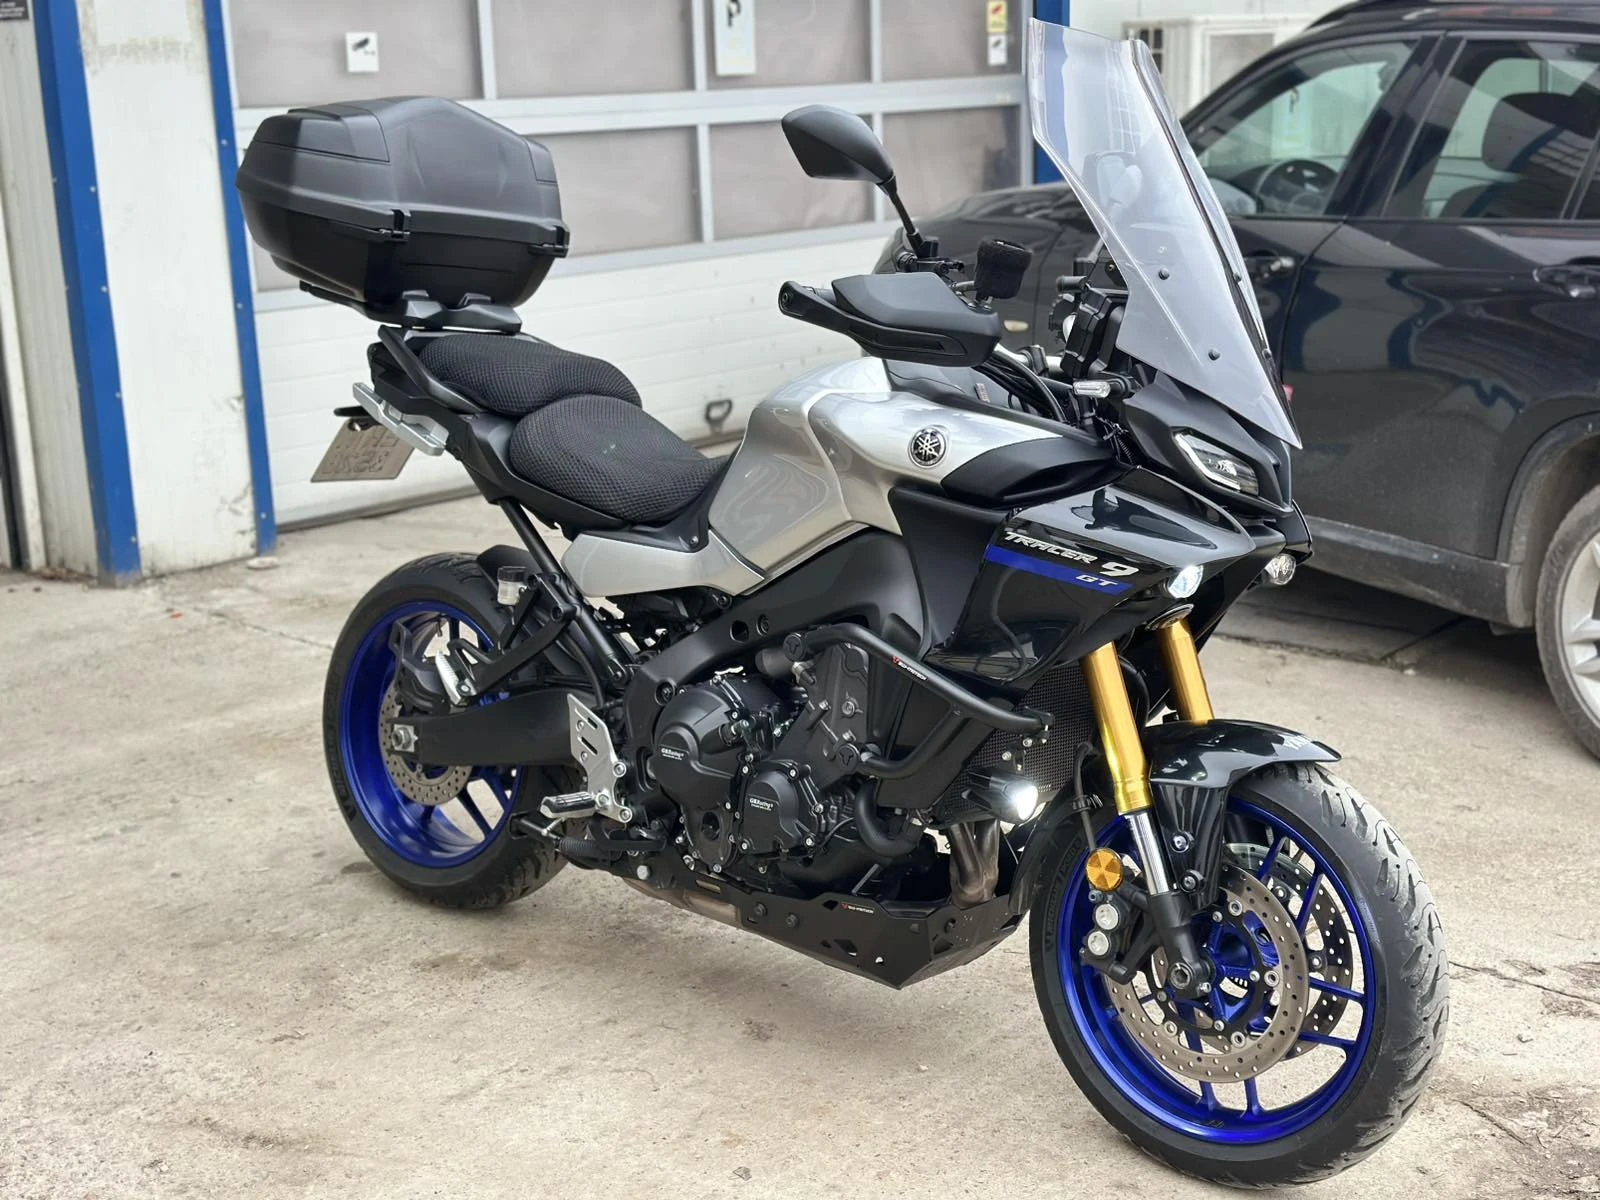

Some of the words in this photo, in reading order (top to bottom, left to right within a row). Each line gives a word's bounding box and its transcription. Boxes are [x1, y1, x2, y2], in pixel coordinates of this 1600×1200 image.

[1004, 531, 1098, 564] TRACER
[1099, 561, 1139, 577] 9
[1075, 574, 1118, 586] GT
